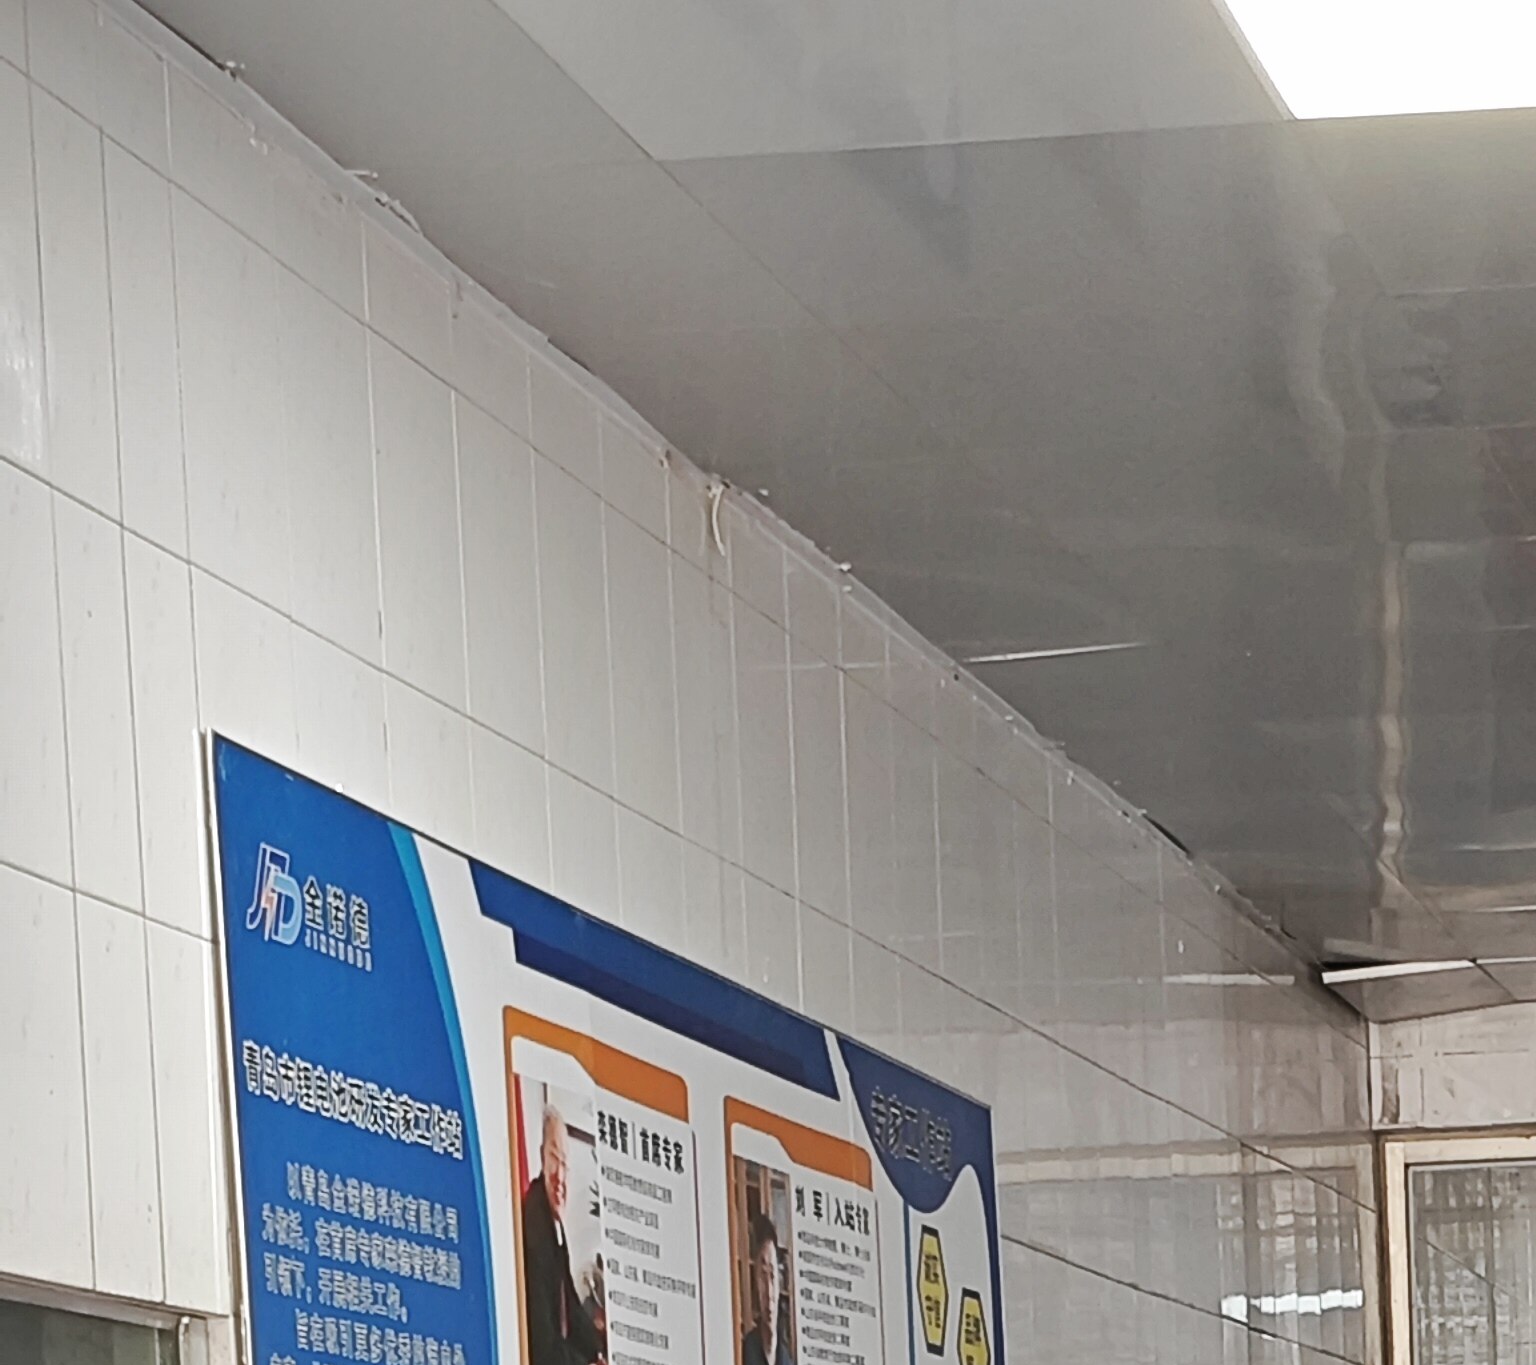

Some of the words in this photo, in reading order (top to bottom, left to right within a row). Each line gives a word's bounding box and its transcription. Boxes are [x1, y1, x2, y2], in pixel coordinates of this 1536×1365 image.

[303, 875, 371, 949] 金诺德
[243, 1040, 463, 1160] 青岛市锂电池研发专家工作站
[639, 1128, 685, 1174] 首席专家
[834, 1198, 870, 1236] 入站专家
